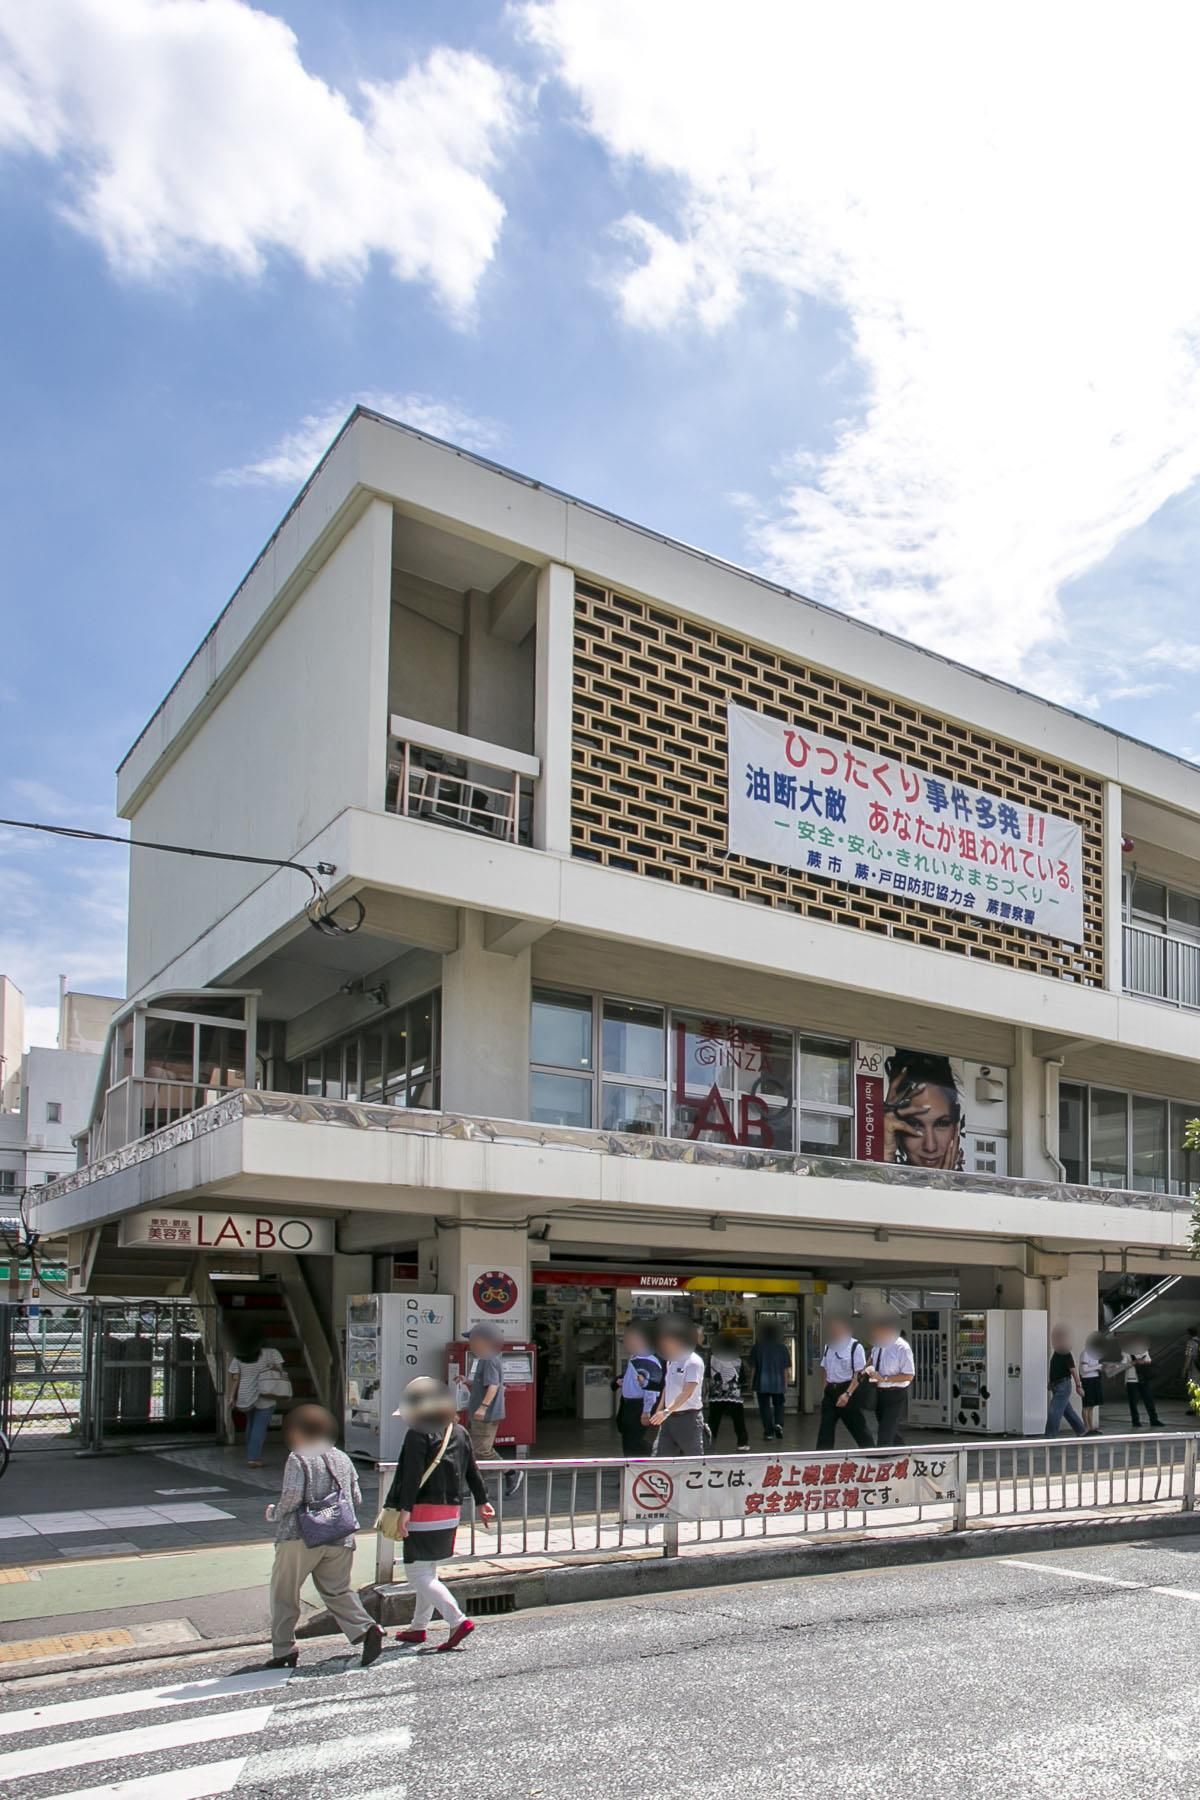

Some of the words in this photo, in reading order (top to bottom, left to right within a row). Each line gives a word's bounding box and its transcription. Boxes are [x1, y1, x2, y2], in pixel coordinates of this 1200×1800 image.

[783, 729, 1045, 847] ひったくり事件多発!!
[745, 763, 847, 824] 油断大敵
[868, 801, 1075, 893] あなたが狙われている。
[855, 863, 976, 909] 蕨・戸田防犯協力会
[985, 898, 1036, 925] 蕨警察署
[694, 1046, 773, 1074] GINZA
[865, 1082, 875, 1100] hair
[865, 1135, 875, 1156] from
[149, 1227, 191, 1240] 美容室
[640, 1276, 678, 1287] NEWDAYS
[406, 1298, 419, 1366] acure
[744, 1485, 900, 1516] 安全歩行区域です。
